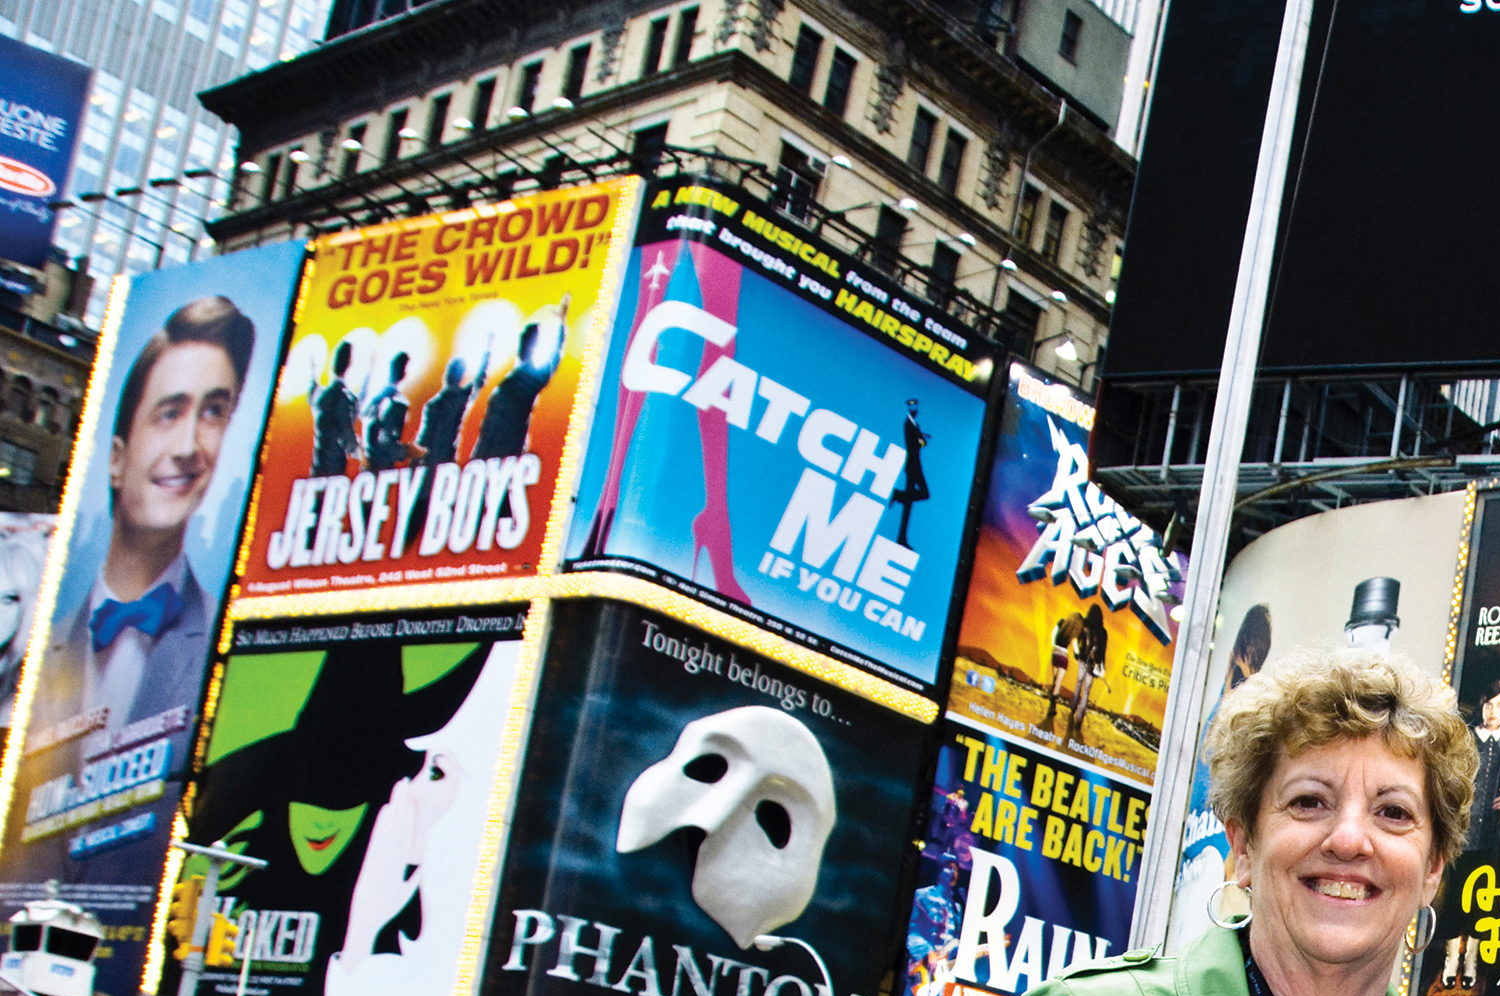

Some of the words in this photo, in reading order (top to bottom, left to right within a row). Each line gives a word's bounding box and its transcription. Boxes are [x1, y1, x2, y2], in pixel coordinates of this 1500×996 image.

[432, 194, 610, 255] CROWD
[651, 190, 671, 209] A
[674, 185, 740, 218] NEW
[741, 209, 841, 280] MUSICAL
[845, 270, 889, 304] from
[891, 297, 922, 324] the
[924, 317, 969, 350] team
[327, 259, 448, 310] GOES
[718, 227, 797, 281] brought
[798, 273, 833, 301] you
[834, 288, 981, 383] HAIRSPRAY
[621, 299, 907, 501] CATCH
[266, 465, 427, 569] JERSEY
[419, 453, 541, 556] BOYS
[769, 466, 921, 606] ME
[467, 561, 508, 575] Street
[757, 551, 796, 580] IF
[797, 567, 863, 613] YOU
[863, 599, 927, 643] CAN
[289, 625, 350, 643] HAPPENED
[350, 622, 395, 640] BEFORE
[395, 618, 454, 636] DOROTHY
[456, 614, 513, 633] DROPPED
[641, 619, 725, 677] Tonight
[727, 662, 808, 711] belongs
[969, 702, 995, 719] Helen
[997, 712, 1026, 730] Hayes
[1028, 723, 1063, 746] Theatre
[1068, 739, 1156, 780] RockOfAgesMusical.c
[970, 791, 1038, 851] ARE
[950, 846, 1112, 993] RAIN
